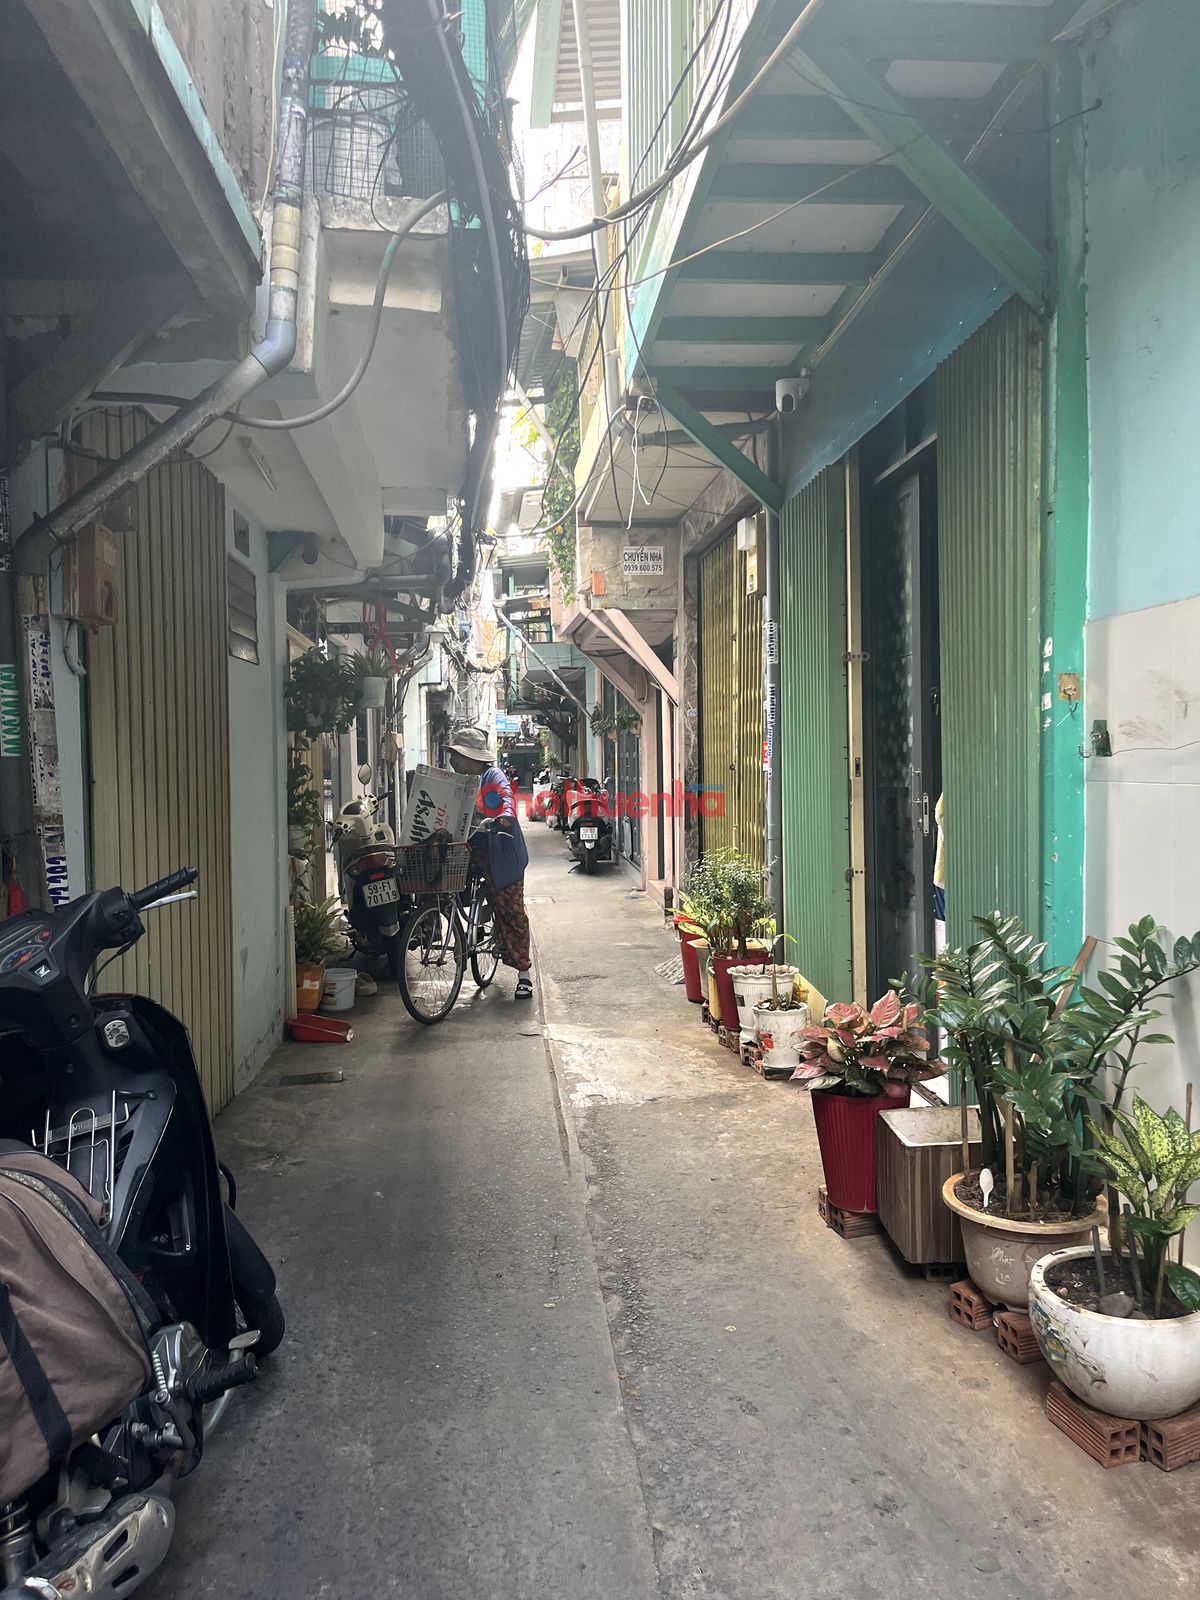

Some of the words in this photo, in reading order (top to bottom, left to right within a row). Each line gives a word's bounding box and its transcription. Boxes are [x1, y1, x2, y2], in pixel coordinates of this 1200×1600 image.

[409, 789, 437, 842] Asahi
[367, 881, 392, 895] 59-F1
[367, 890, 398, 906] 701.19
